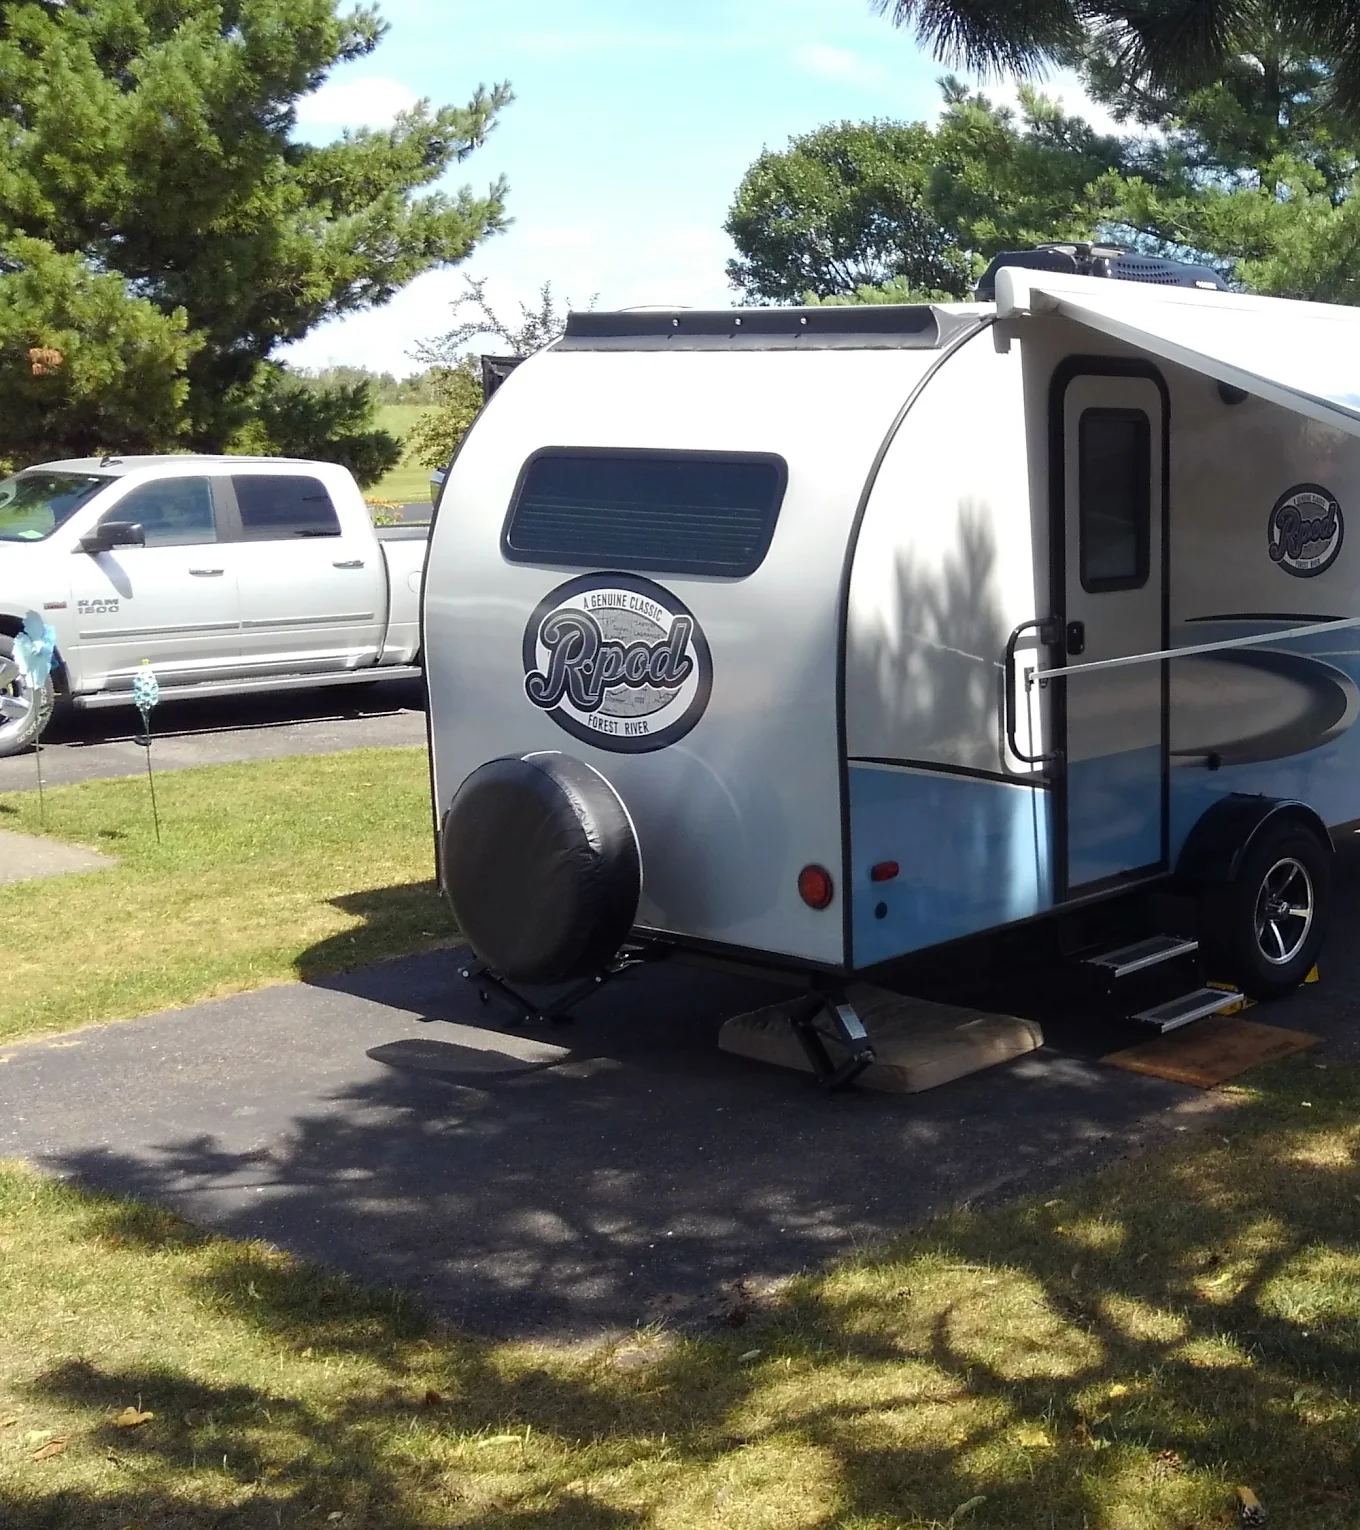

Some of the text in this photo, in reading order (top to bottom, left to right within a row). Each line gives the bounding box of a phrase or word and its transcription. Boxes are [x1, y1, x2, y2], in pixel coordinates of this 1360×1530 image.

[78, 606, 119, 614] 1500
[584, 593, 663, 621] A GENUINE CLASSIC
[588, 714, 649, 735] FOREST RIVER
